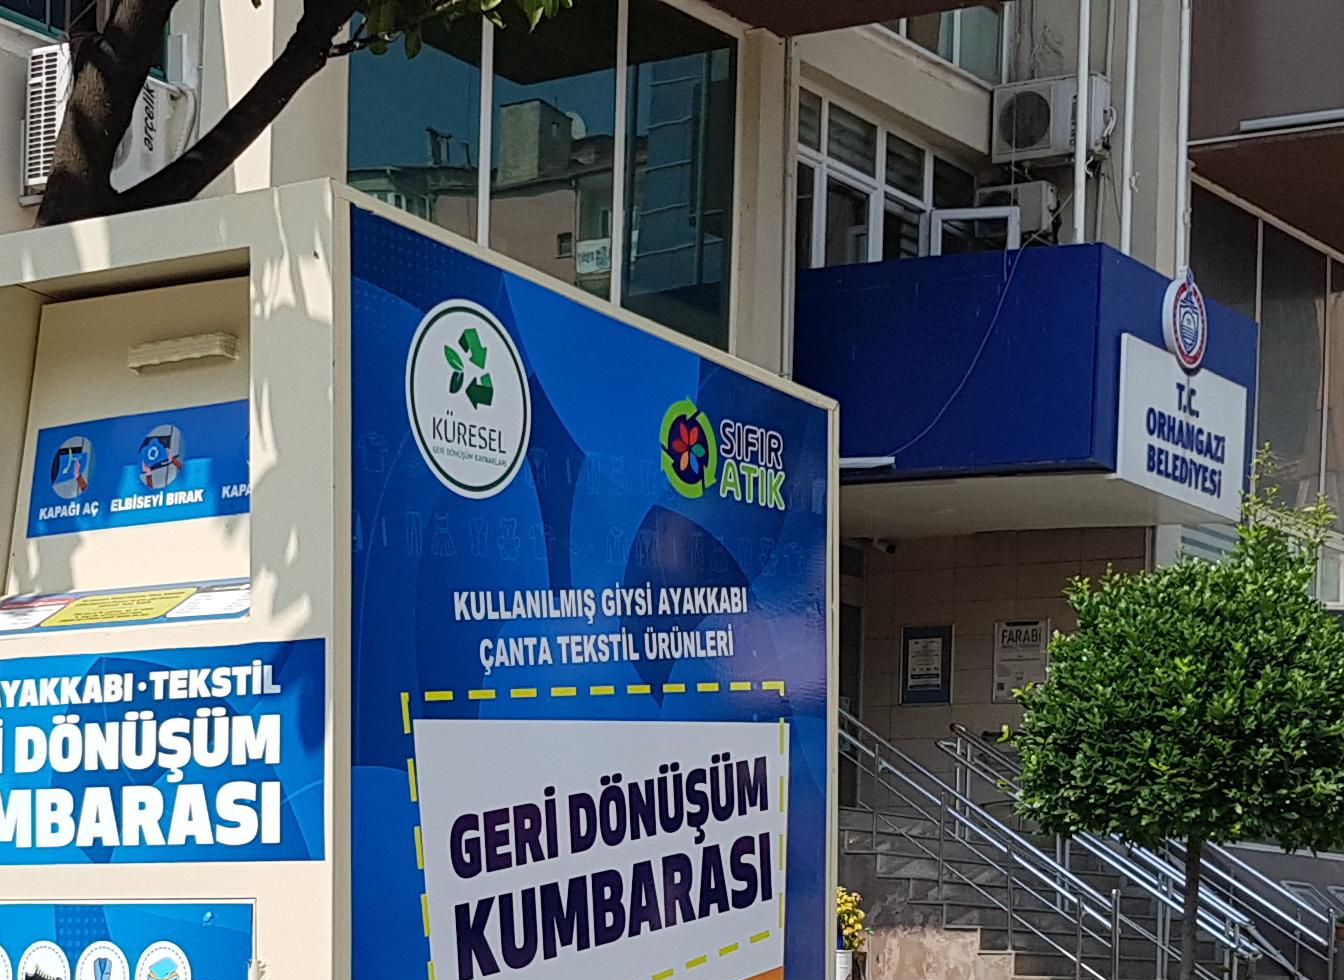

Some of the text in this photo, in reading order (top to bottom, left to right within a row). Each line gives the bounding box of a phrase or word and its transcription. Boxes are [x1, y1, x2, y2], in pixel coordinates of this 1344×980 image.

[1176, 382, 1200, 418] T.C.
[433, 410, 506, 454] KÜRESEL
[720, 419, 783, 469] SIFIR
[110, 489, 203, 512] ELBİSEYİ BIRAK
[720, 459, 785, 511] ATIK
[39, 501, 99, 520] KAPAĞI AÇ
[453, 582, 747, 624] KULLANILMIŞ GİYSİ AYAKKABI
[480, 623, 734, 675] ÇANTA TEKSTİL ÜRÜNLERİ
[149, 660, 281, 699] TEKSTİL
[14, 707, 281, 783] DÖNÜŞÜM
[450, 752, 769, 880] GERİ DÖNÜŞÜM
